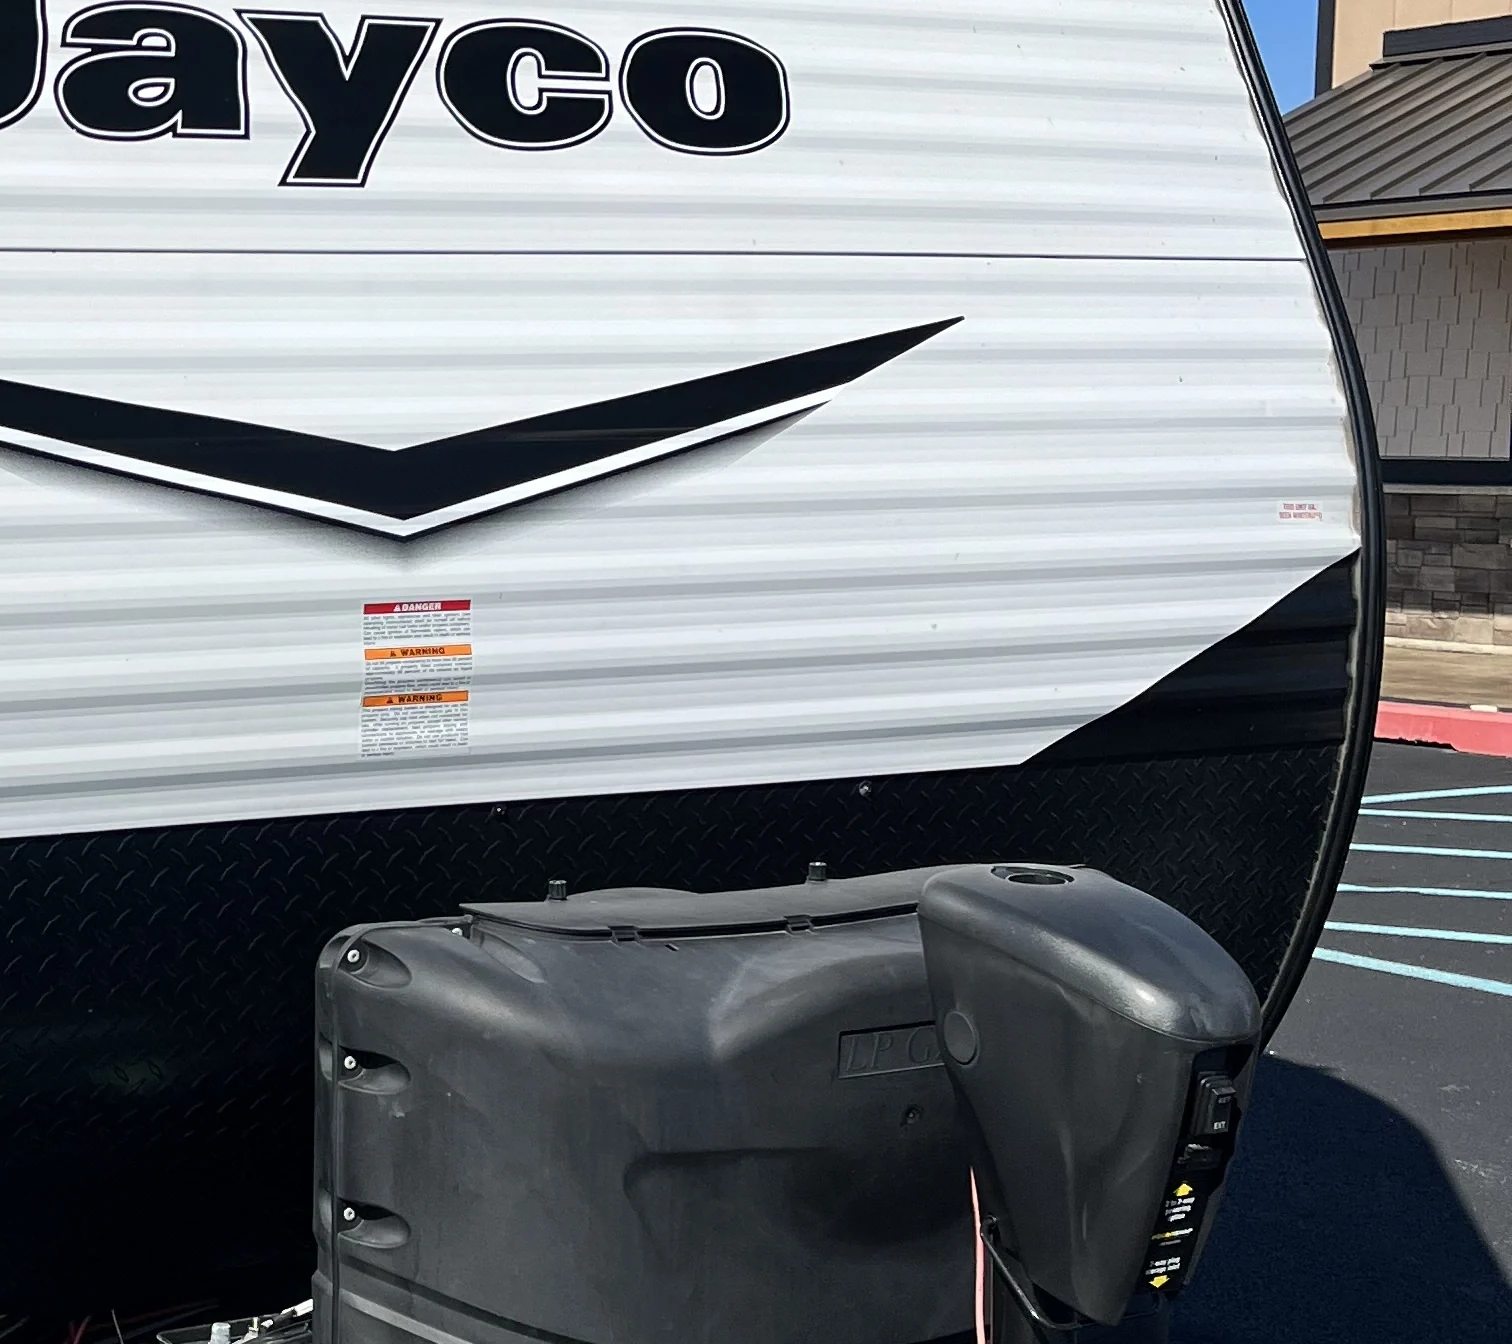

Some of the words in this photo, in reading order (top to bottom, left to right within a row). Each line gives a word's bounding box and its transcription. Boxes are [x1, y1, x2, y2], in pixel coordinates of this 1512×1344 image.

[401, 602, 442, 612] DANGER
[400, 647, 446, 657] WARNING
[398, 693, 443, 704] WARNING
